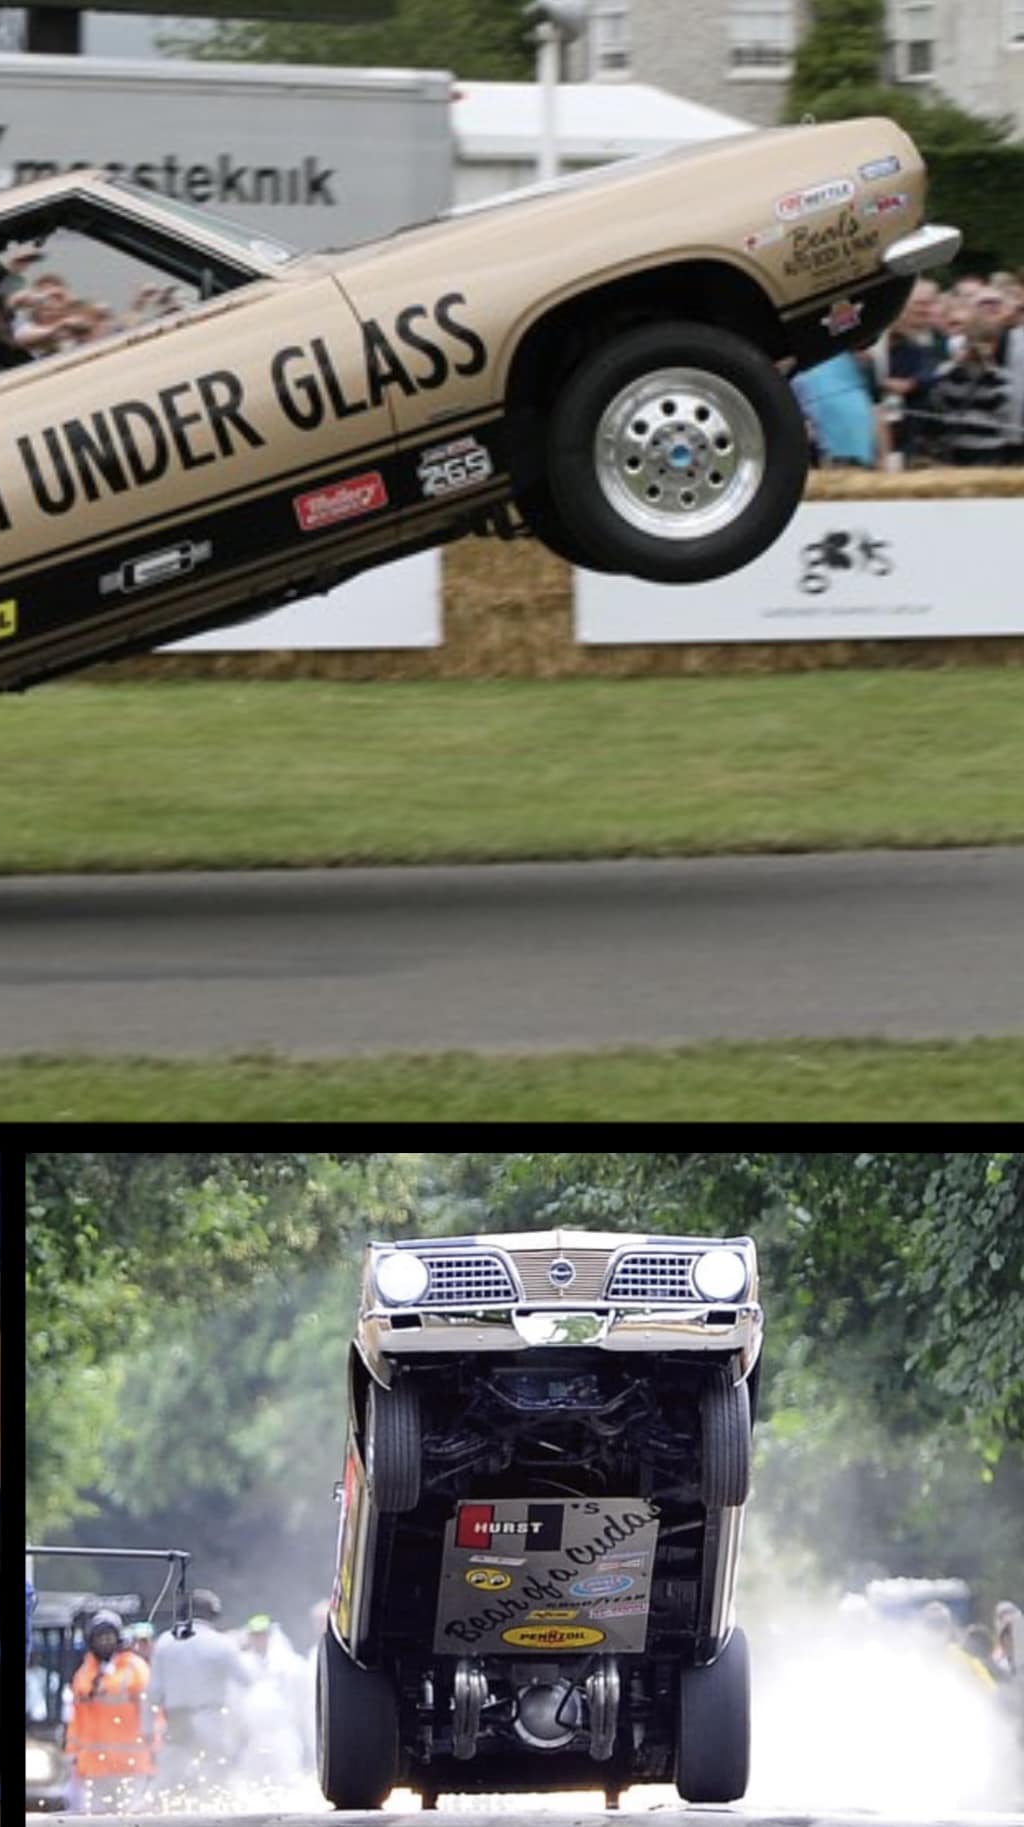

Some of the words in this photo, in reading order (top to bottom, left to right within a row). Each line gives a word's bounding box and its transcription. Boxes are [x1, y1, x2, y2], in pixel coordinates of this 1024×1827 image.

[17, 370, 266, 517] UNDER
[271, 292, 488, 431] GLASS
[474, 1521, 544, 1534] HURST
[522, 1575, 563, 1600] of
[548, 1568, 579, 1582] a
[519, 1631, 585, 1642] PENNZOIL
